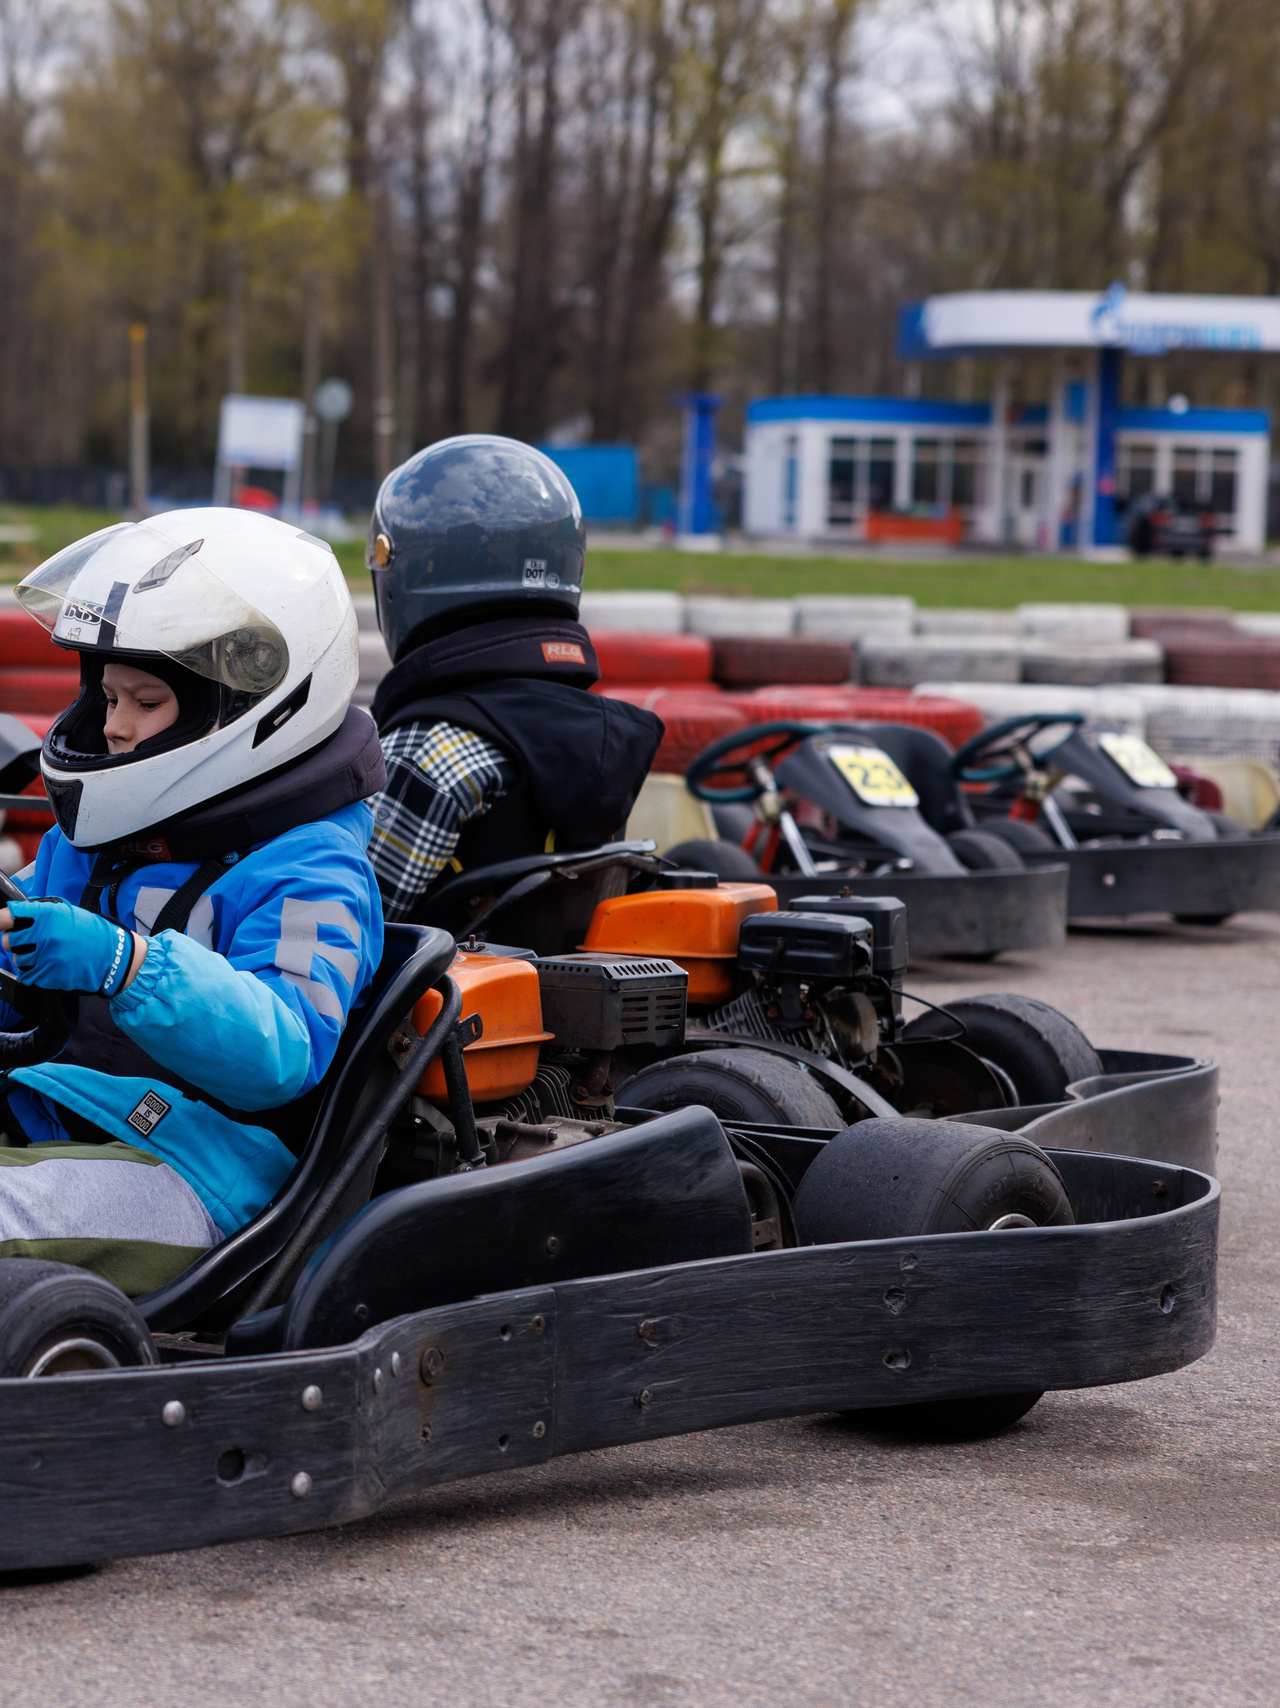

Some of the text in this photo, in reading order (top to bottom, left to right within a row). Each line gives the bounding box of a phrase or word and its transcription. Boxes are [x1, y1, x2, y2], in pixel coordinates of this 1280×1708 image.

[525, 569, 544, 580] DOT
[547, 645, 581, 657] RLG
[847, 763, 904, 791] 23
[103, 927, 126, 990] cyclotech
[145, 1096, 164, 1114] GOOD
[132, 1113, 151, 1131] GOOD
